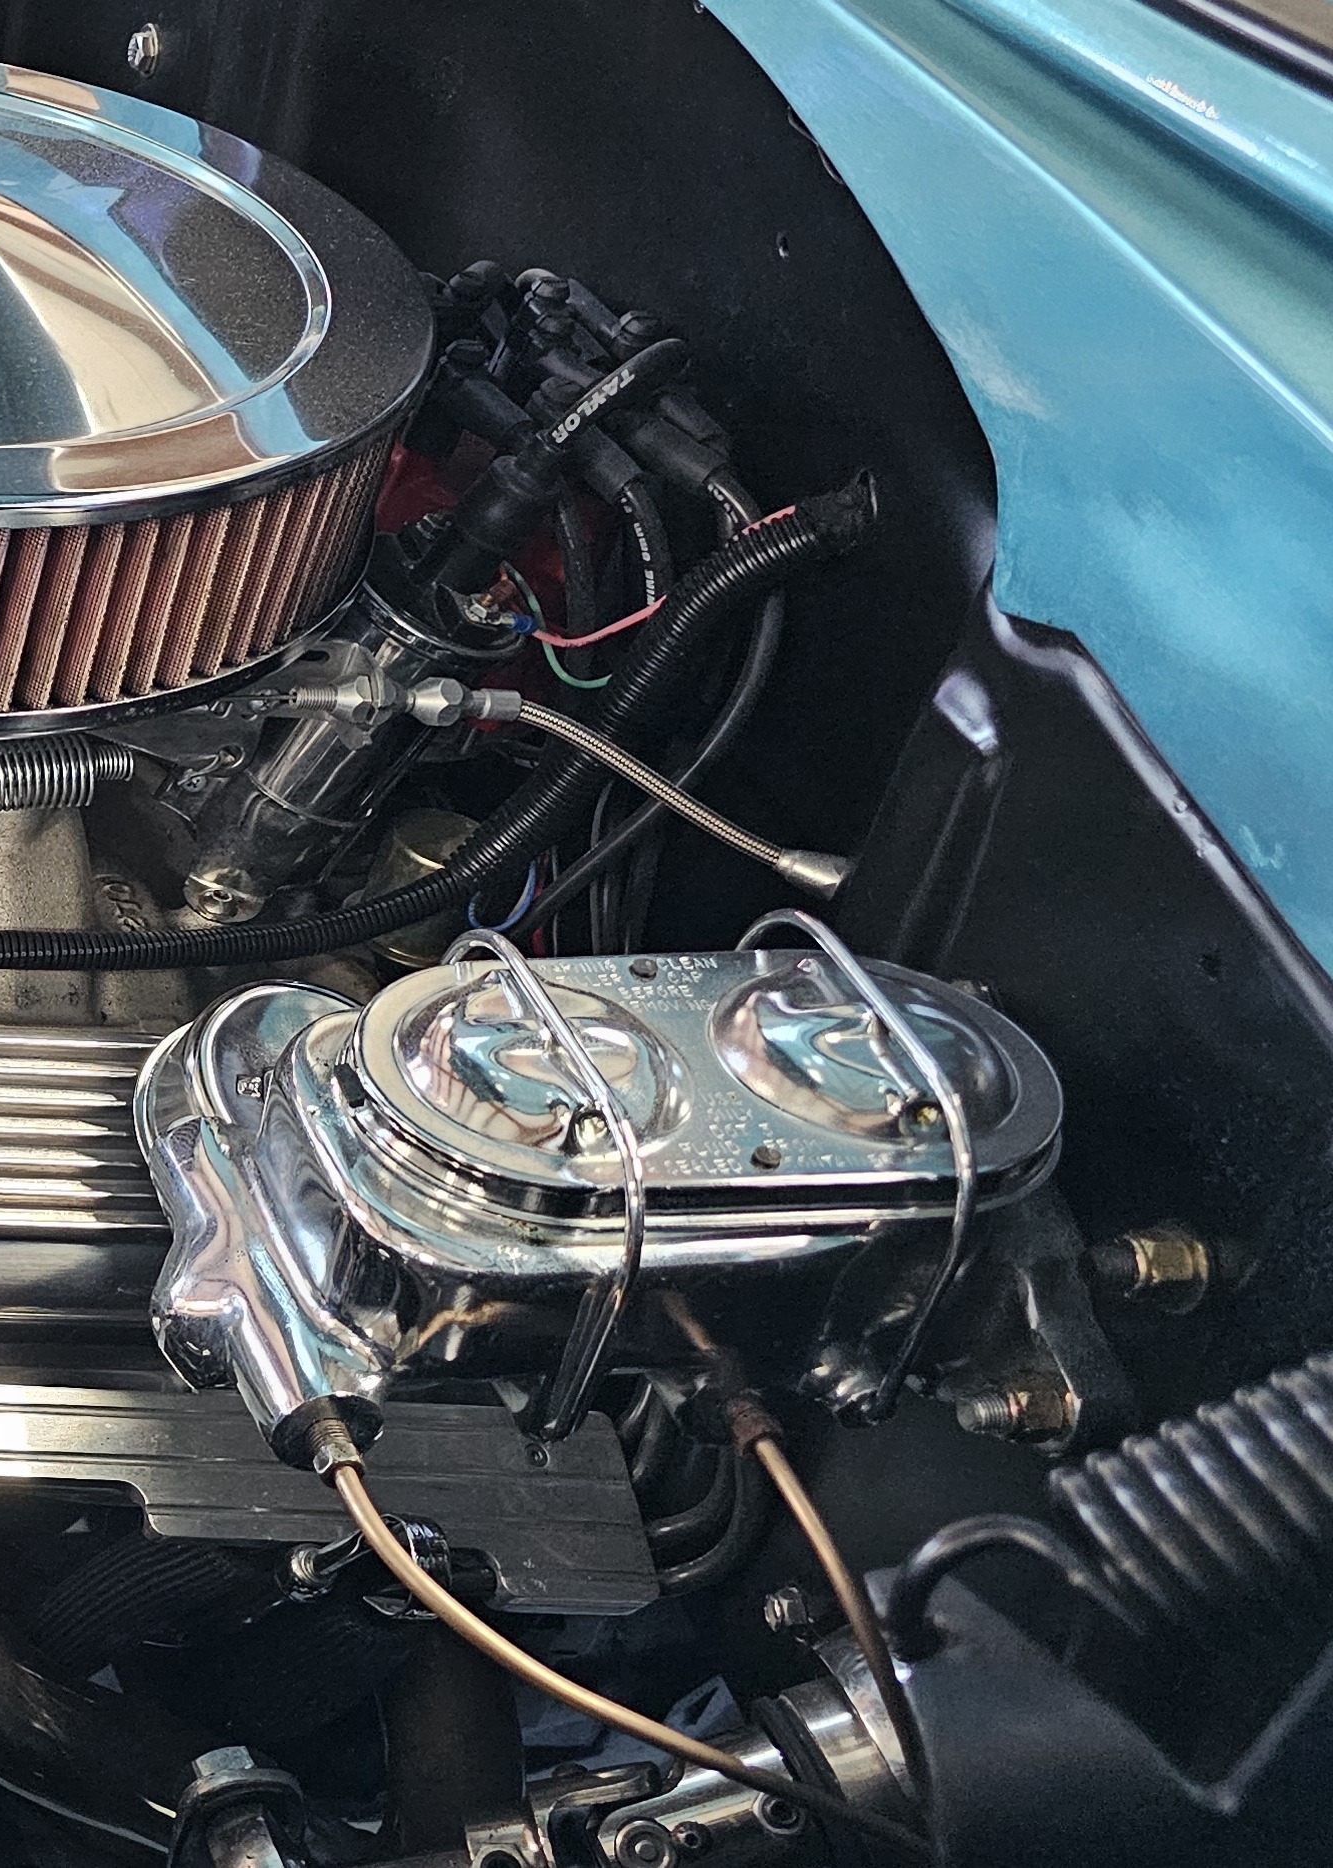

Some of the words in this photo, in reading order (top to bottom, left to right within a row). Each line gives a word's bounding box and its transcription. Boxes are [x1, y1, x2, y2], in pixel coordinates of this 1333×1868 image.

[551, 367, 636, 444] TAYLOR
[655, 955, 719, 972] CLEAN
[667, 970, 704, 985] CAP
[617, 984, 695, 1001] BEFORE
